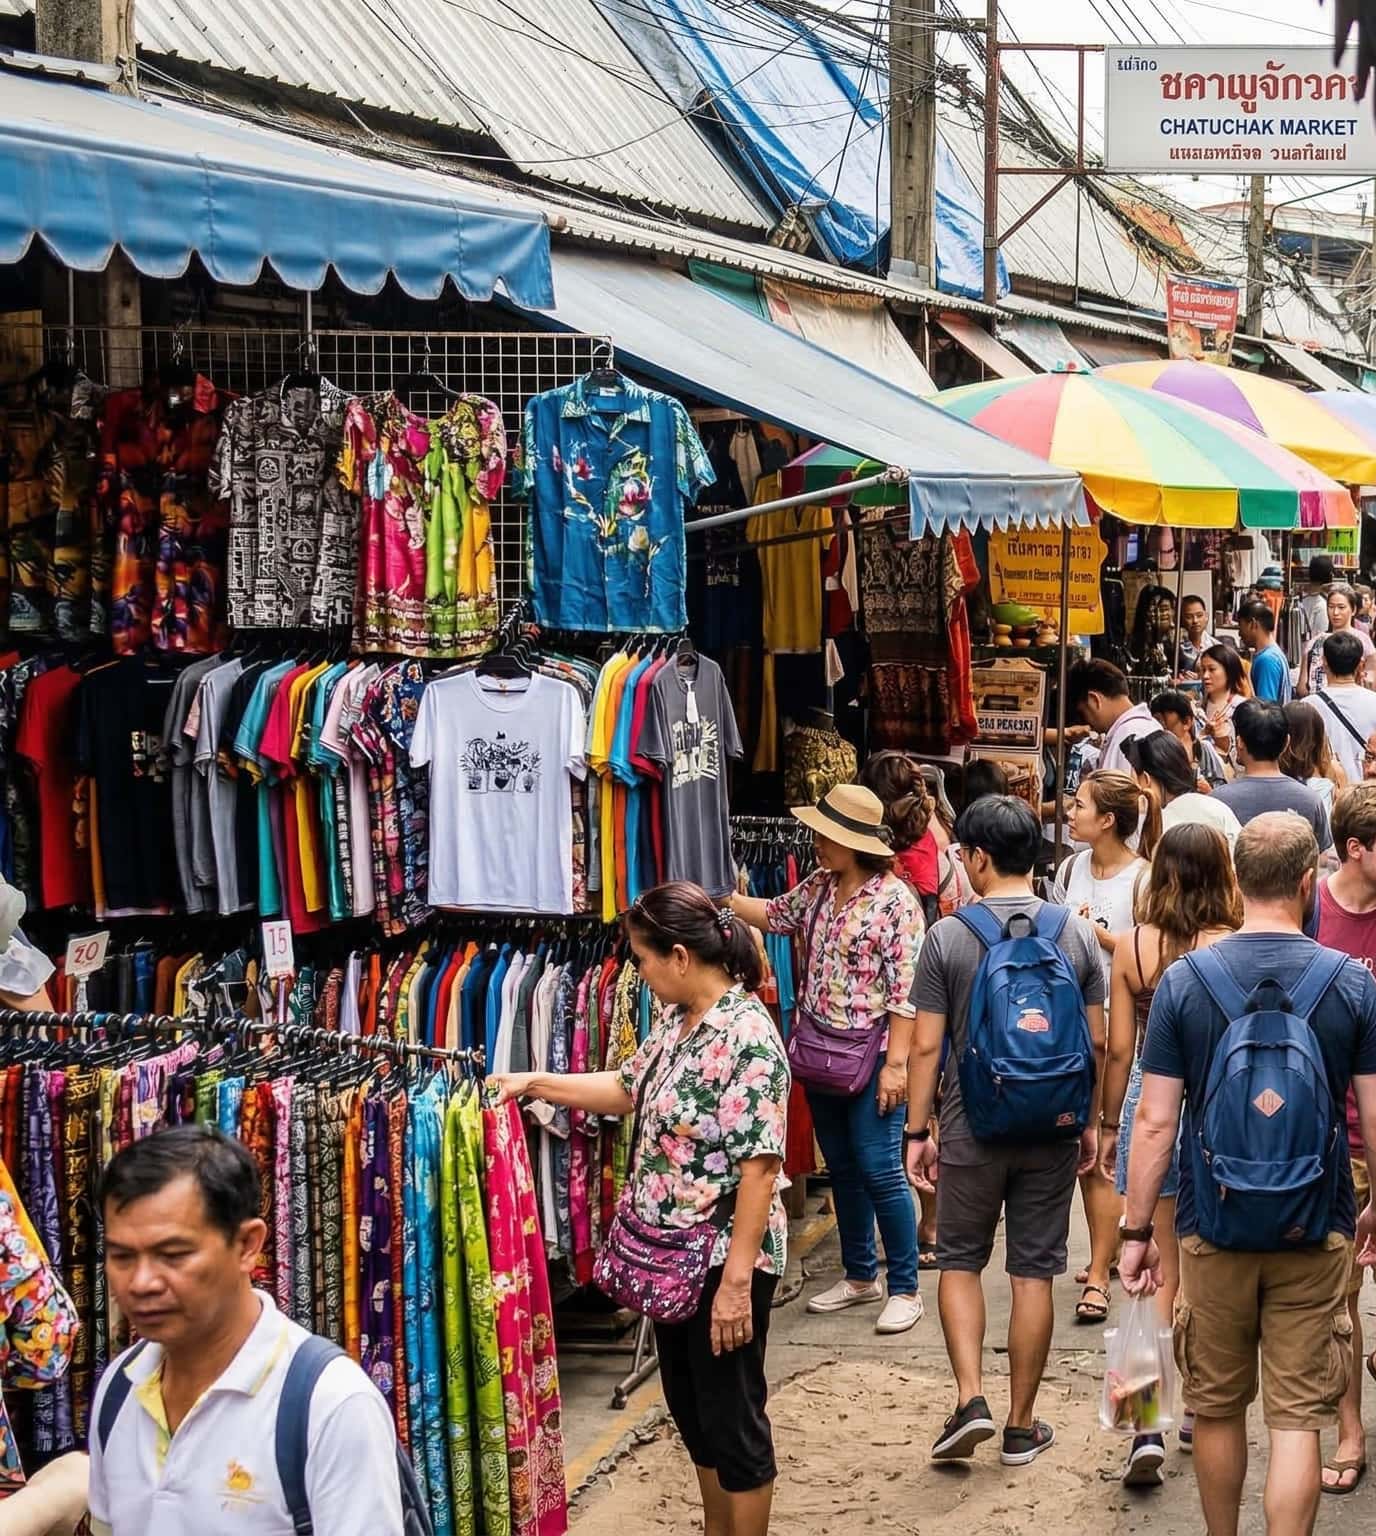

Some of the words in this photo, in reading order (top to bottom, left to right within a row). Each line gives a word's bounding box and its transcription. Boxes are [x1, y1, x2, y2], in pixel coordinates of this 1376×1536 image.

[1160, 118, 1274, 136] CHATUCHAK
[1279, 119, 1358, 136] MARKET
[268, 927, 287, 955] 15
